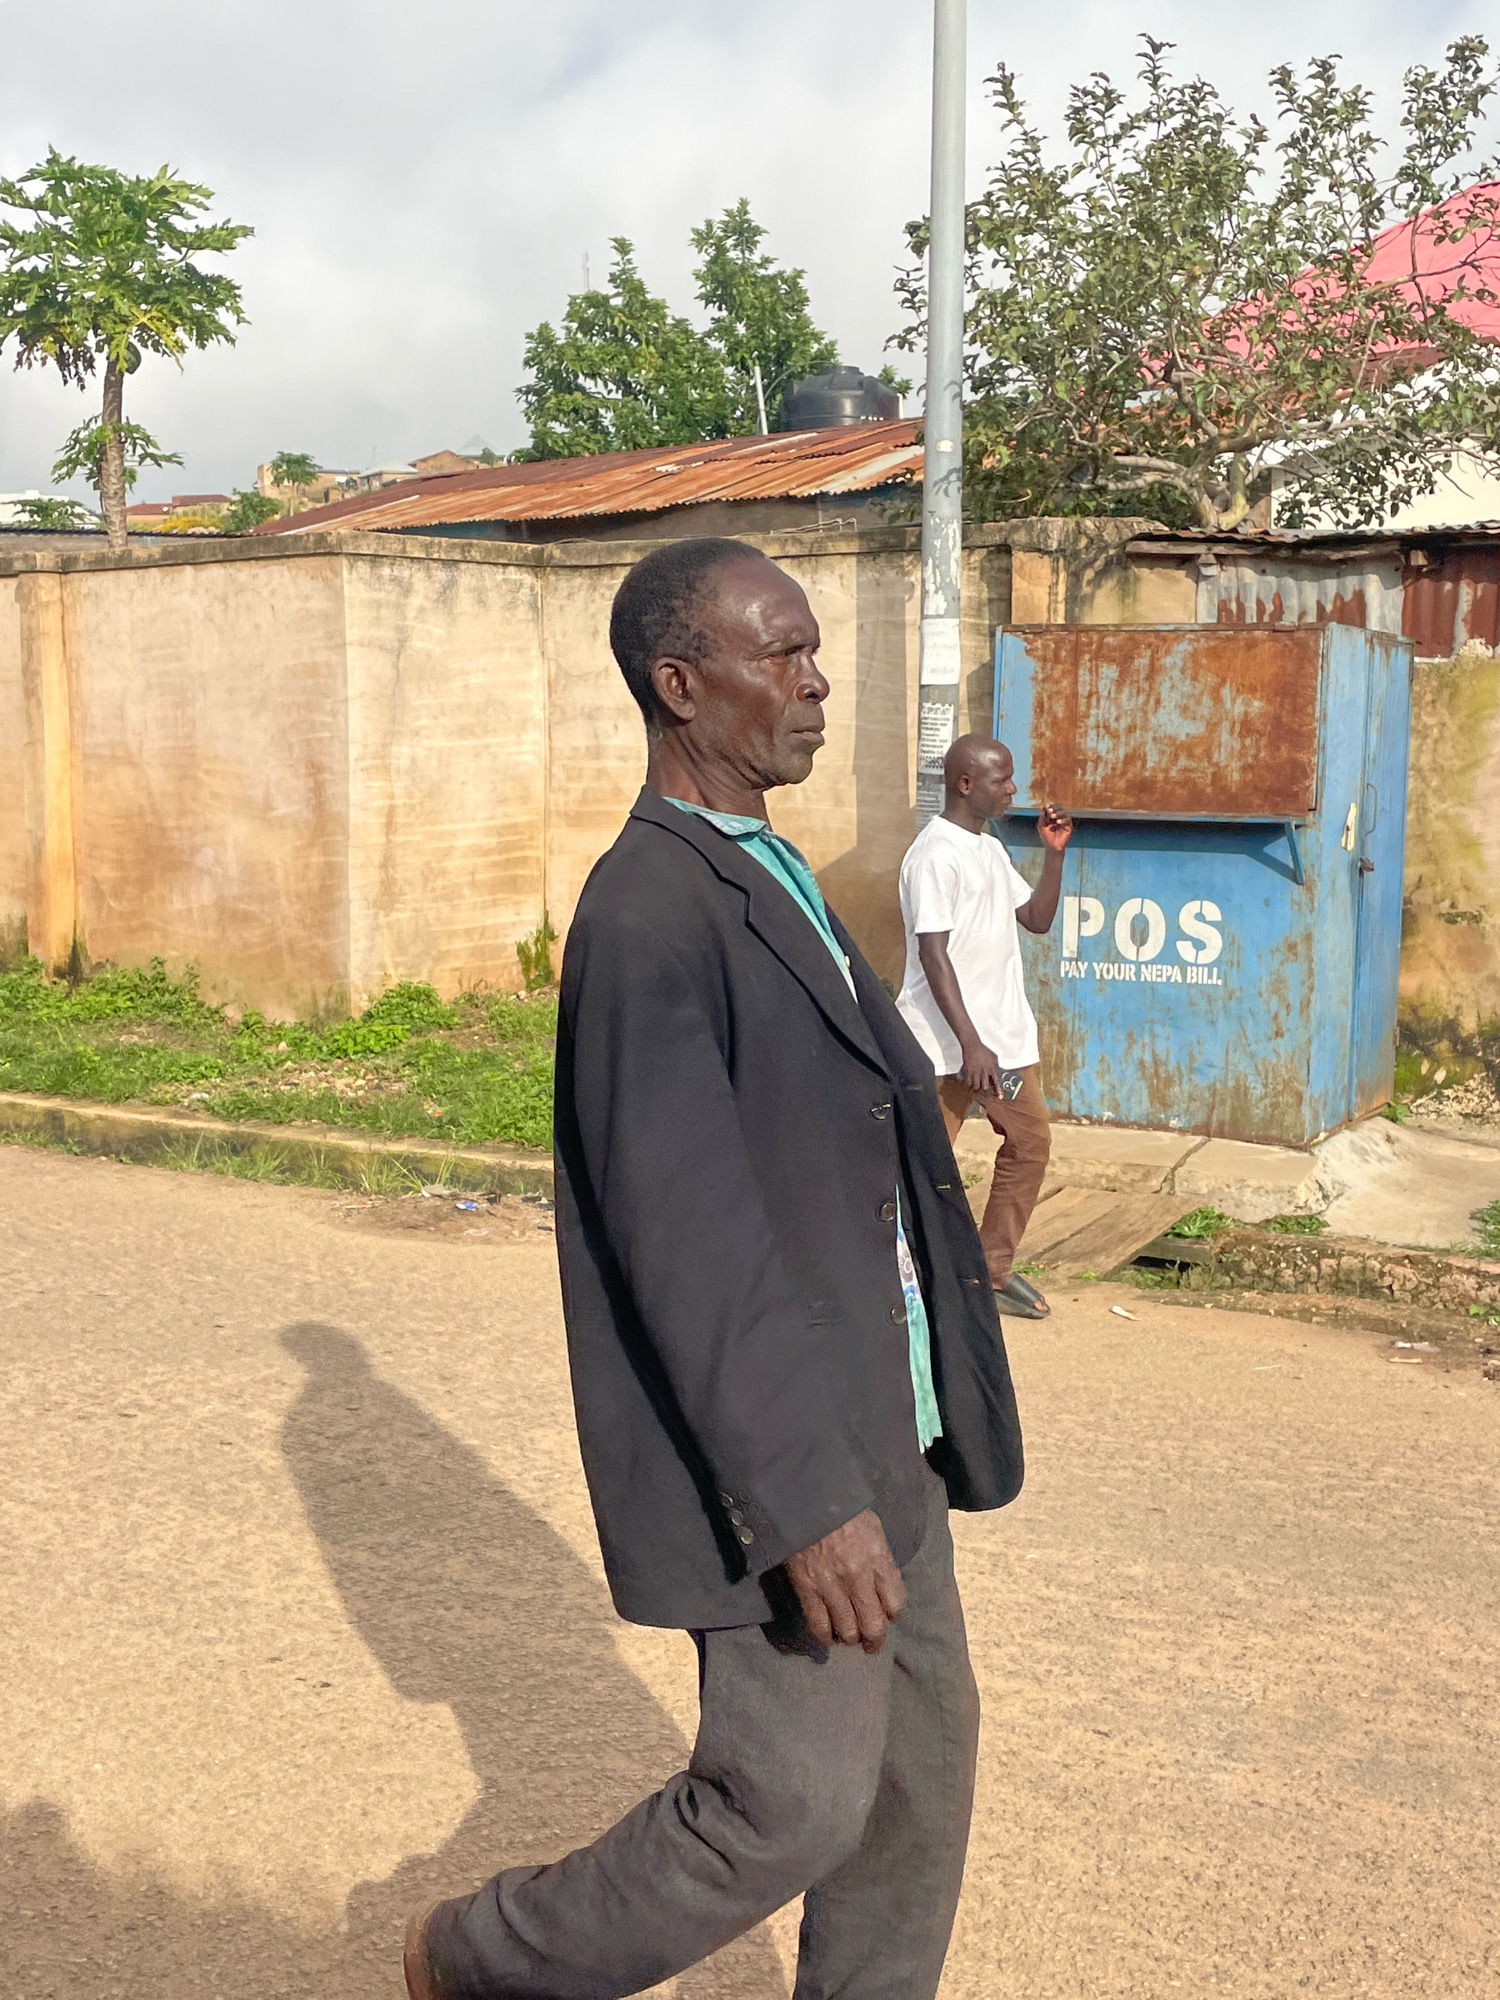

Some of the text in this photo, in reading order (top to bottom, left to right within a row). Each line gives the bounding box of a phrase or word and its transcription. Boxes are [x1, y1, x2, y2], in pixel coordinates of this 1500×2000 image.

[1062, 896, 1223, 965] POS
[1060, 960, 1223, 985] PAY YOUR NEPA BILL
